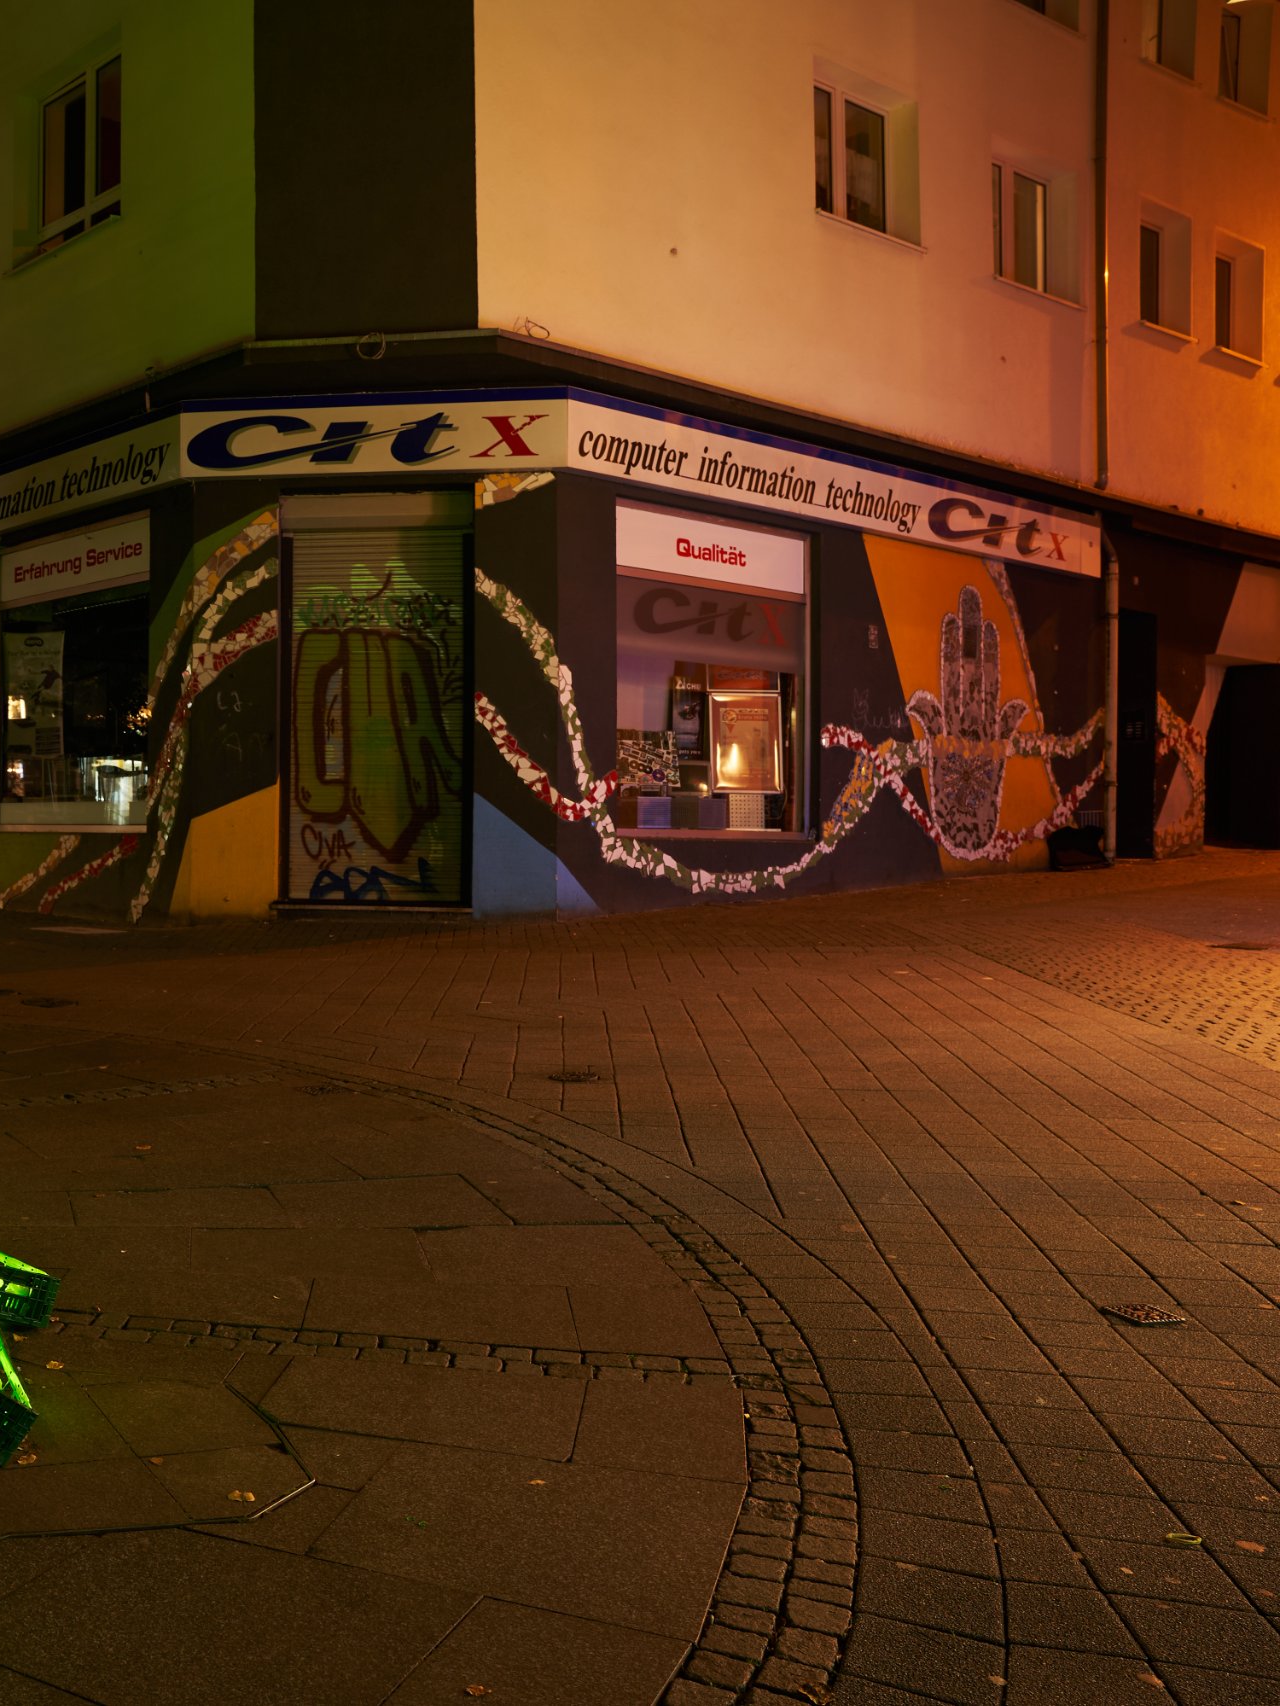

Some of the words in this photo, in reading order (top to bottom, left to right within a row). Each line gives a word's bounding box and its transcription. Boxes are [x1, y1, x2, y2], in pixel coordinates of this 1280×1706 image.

[14, 556, 82, 584] Erfahrung
[86, 542, 143, 567] Service
[676, 538, 746, 567] Qualität
